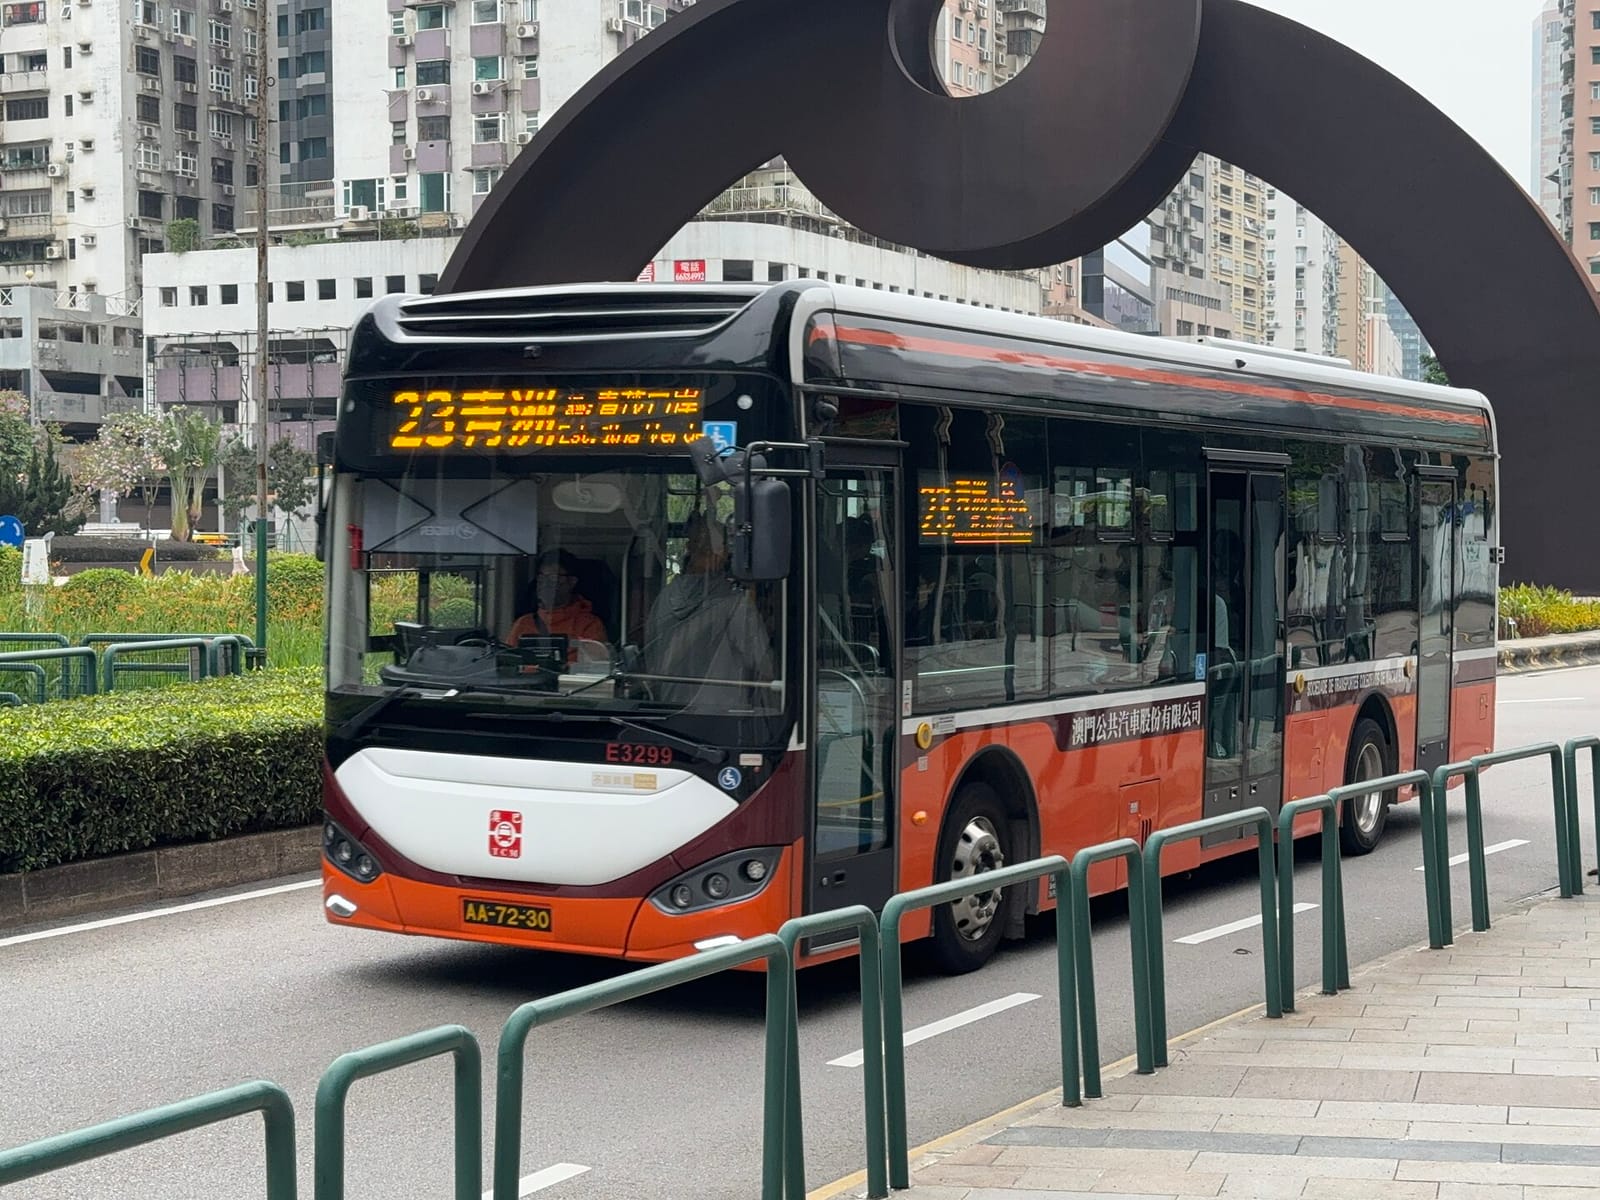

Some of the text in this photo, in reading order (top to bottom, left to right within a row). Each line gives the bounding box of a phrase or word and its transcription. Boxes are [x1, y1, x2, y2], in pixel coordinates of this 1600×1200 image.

[392, 391, 455, 447] 23
[1072, 700, 1201, 745] 澳門公共汽車股份有限公司
[606, 743, 673, 765] E3299
[492, 847, 519, 858] TCM
[465, 903, 550, 929] AA-72-30
